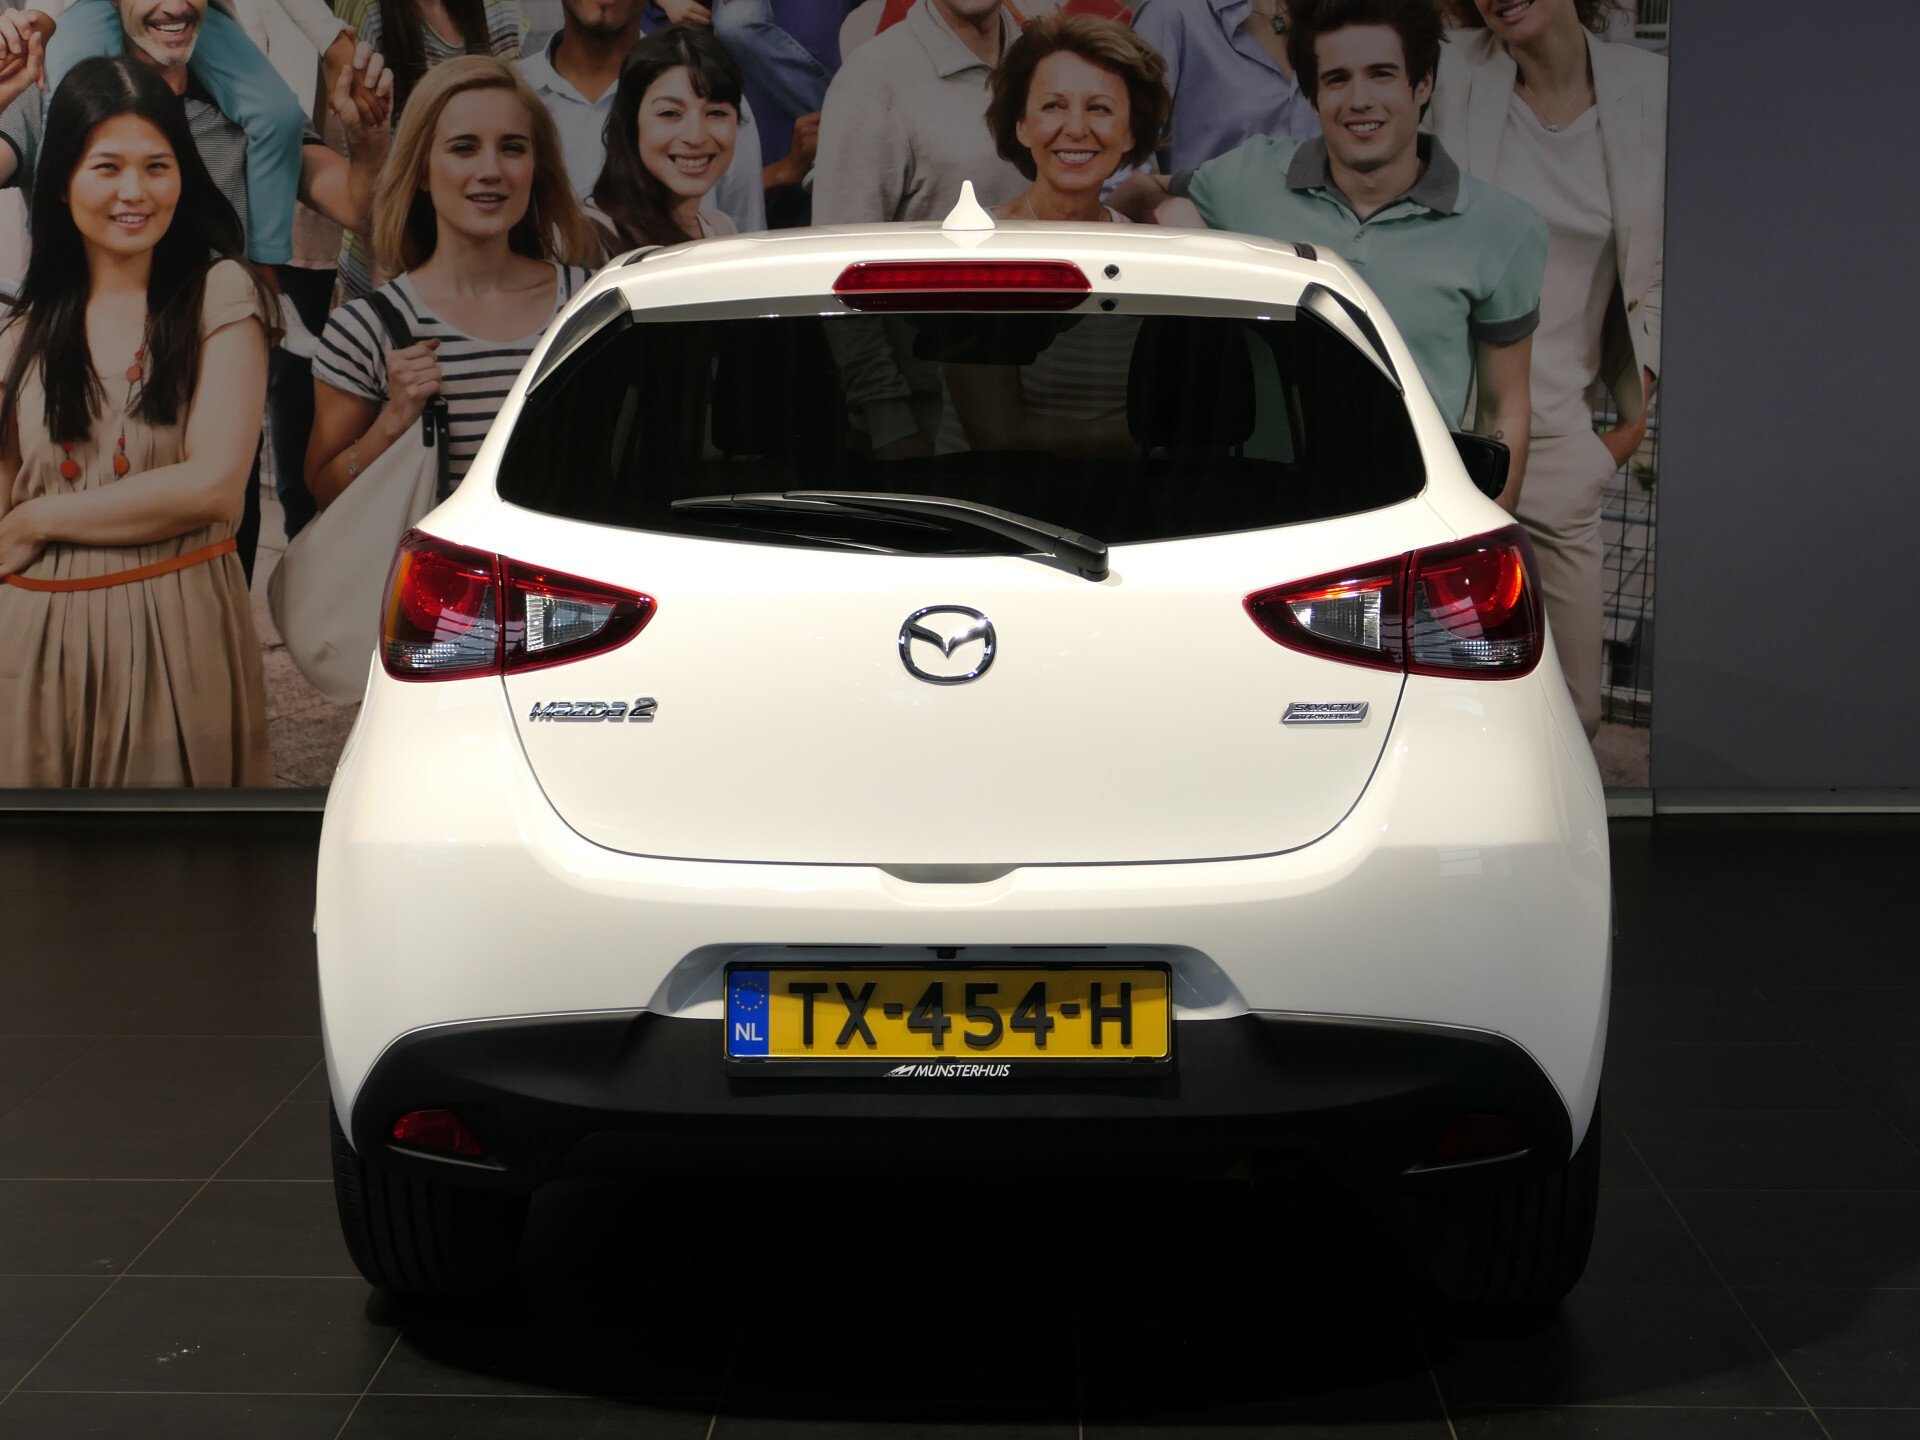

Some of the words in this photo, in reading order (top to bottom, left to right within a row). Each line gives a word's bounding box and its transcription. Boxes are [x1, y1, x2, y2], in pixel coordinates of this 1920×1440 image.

[629, 697, 658, 722] 2
[1294, 703, 1361, 711] SKYACTIV
[788, 981, 1133, 1048] TX-454-H
[735, 1022, 763, 1041] NL
[914, 1064, 1011, 1077] MUNSTERHUIS
